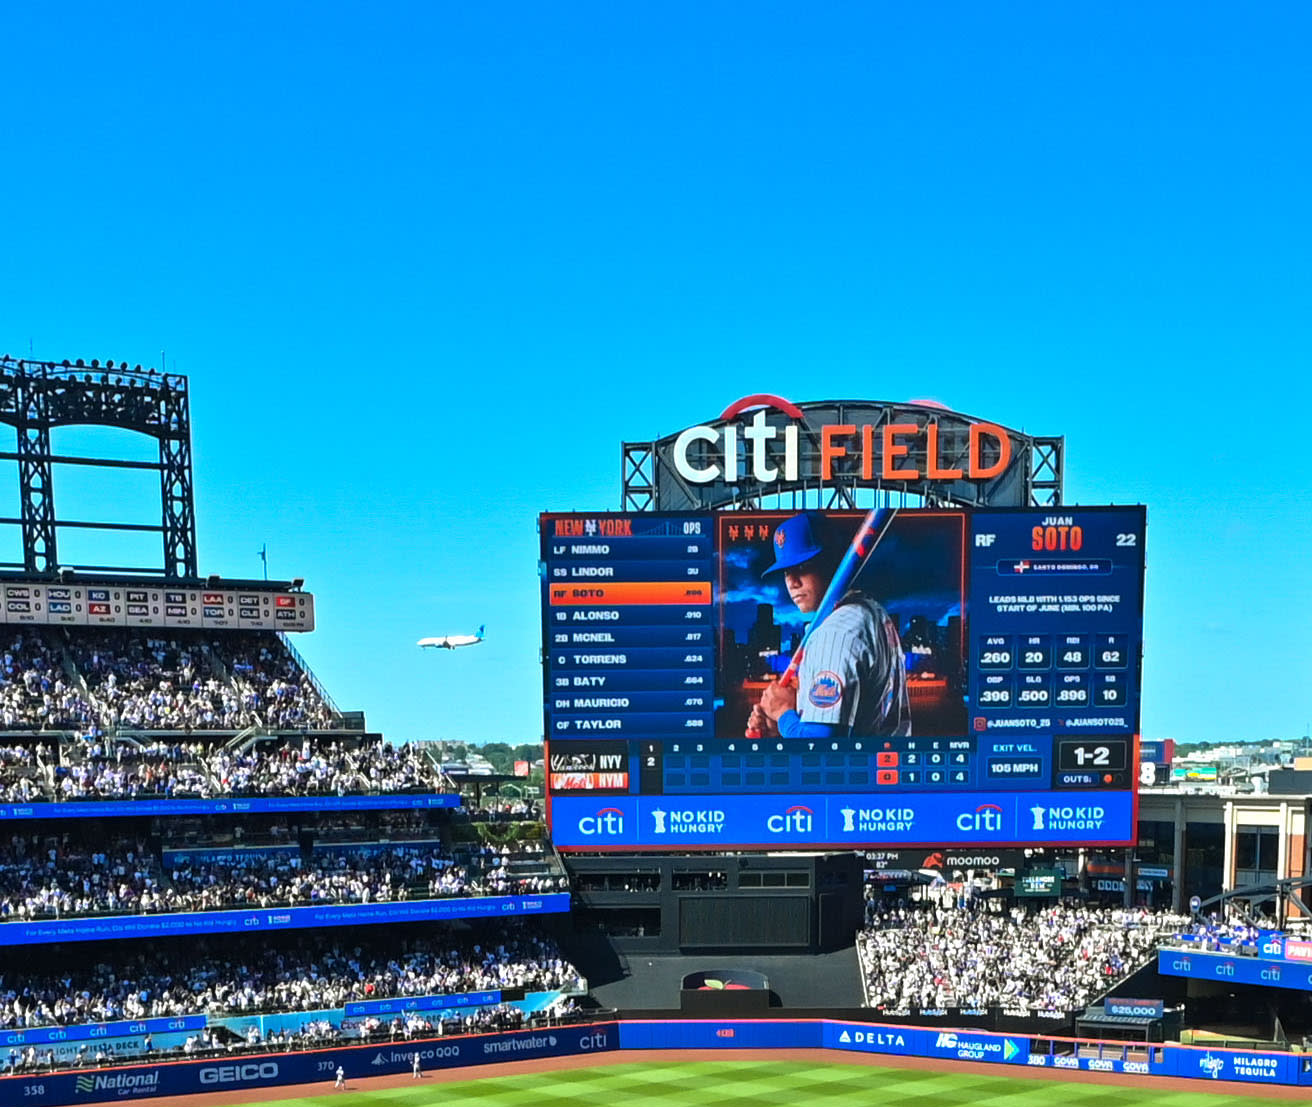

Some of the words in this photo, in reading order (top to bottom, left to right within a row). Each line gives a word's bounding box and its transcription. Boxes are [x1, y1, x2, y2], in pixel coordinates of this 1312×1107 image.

[821, 422, 1011, 481] FIELD
[1042, 517, 1073, 526] JUAN
[555, 520, 584, 536] NEW
[599, 520, 632, 536] YORK
[683, 522, 701, 534] OPS
[975, 534, 996, 547] RF
[1032, 526, 1083, 551] SOTO
[1116, 533, 1136, 546] 22
[572, 545, 610, 554] NIMMO
[572, 567, 614, 576] LINDOR
[573, 589, 604, 597] SOTO
[573, 611, 620, 620] ALONSO
[573, 633, 615, 642] MCNEIL
[573, 655, 627, 664] TORRENS
[981, 652, 1010, 663] .260
[1025, 652, 1043, 663] 20
[1063, 652, 1082, 662] 48
[1102, 651, 1119, 662] 62
[574, 677, 606, 686] BATY
[980, 691, 1009, 702] .396
[1018, 690, 1048, 701] .500
[1057, 690, 1086, 701] .896
[1103, 690, 1117, 700] 10
[556, 700, 570, 708] DH
[574, 698, 629, 707] MAURICIO
[575, 720, 622, 729] TAYLOR
[993, 744, 1015, 752] EXIT
[1017, 744, 1037, 752] VEL.
[1074, 747, 1110, 765] 1-2
[992, 763, 1012, 773] 105
[1013, 763, 1038, 773] MPH
[671, 811, 694, 823] NO
[697, 811, 725, 822] KID
[859, 809, 883, 821] NO
[886, 809, 914, 820] KID
[1049, 808, 1073, 819] NO
[1077, 808, 1104, 819] KID
[578, 812, 623, 834] citi
[767, 811, 812, 833] citi
[956, 810, 1001, 831] citi
[1049, 820, 1103, 830] HUNGRY
[671, 823, 724, 833] HUNGRY
[859, 822, 913, 831] HUNGRY
[947, 856, 1000, 865] moomoo
[483, 1036, 549, 1054] smartwater
[855, 1032, 905, 1047] DELTA
[957, 1041, 1001, 1053] HAUGLAND
[957, 1049, 984, 1059] GROUP
[317, 1061, 335, 1071] 370
[1028, 1055, 1045, 1066] 380
[1233, 1057, 1278, 1068] MILAGRO
[200, 1063, 279, 1084] GEICO
[1234, 1066, 1276, 1077] TEQUILA
[95, 1071, 159, 1091] National
[24, 1085, 45, 1096] 358
[118, 1088, 130, 1096] Car
[133, 1086, 156, 1095] Rental
